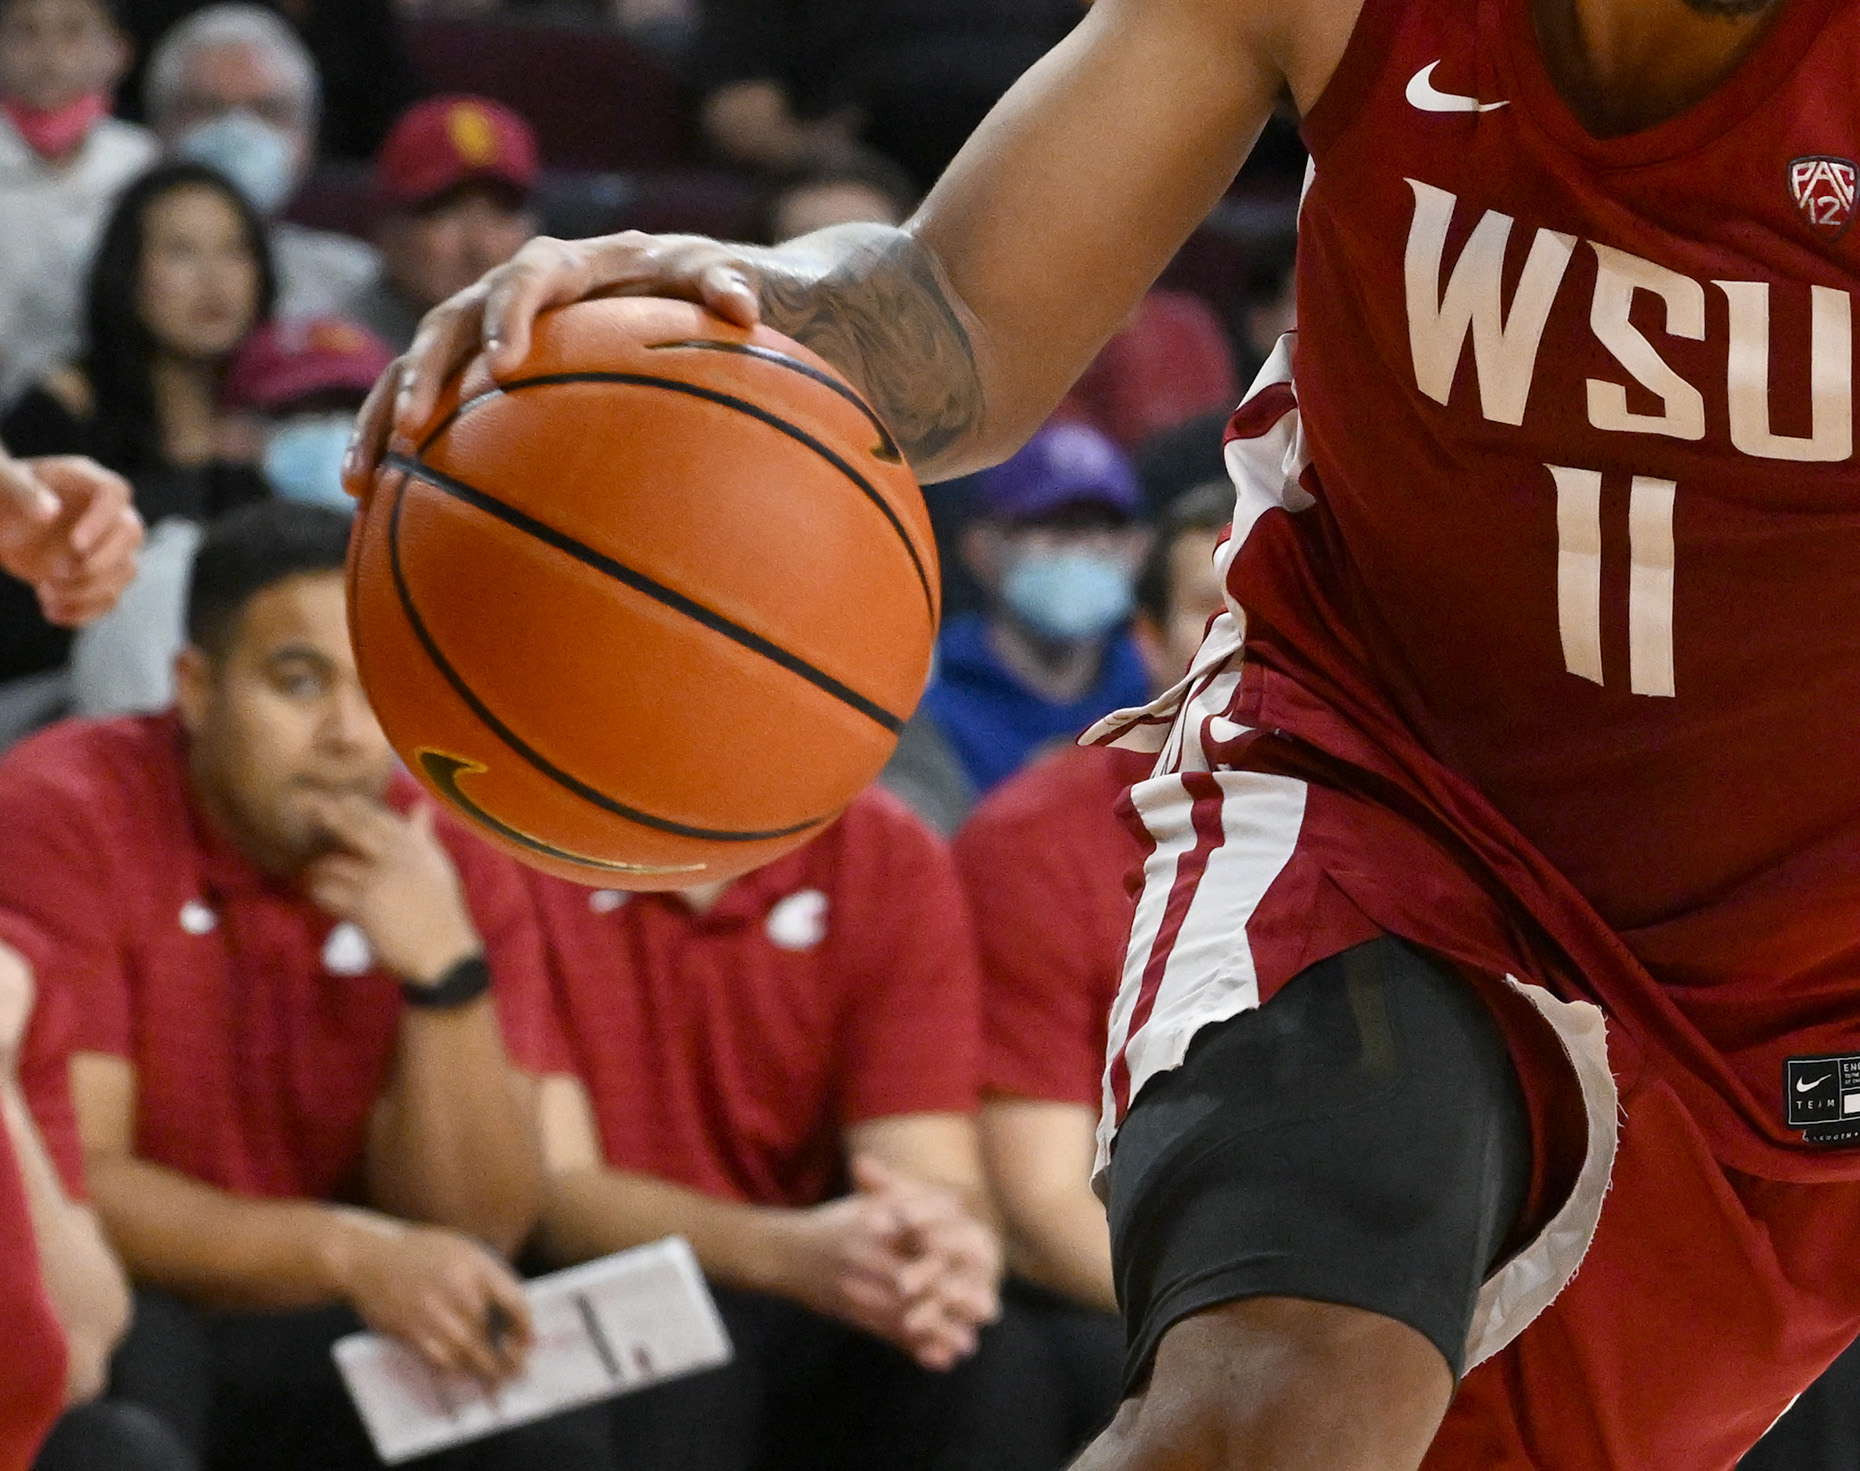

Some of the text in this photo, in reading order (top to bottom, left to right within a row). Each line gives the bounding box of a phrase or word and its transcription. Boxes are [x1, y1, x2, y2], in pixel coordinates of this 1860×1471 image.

[1792, 161, 1855, 212] PAC
[1808, 196, 1841, 225] 12
[1403, 177, 1853, 462] WSU
[1542, 463, 1677, 698] 11
[1796, 1098, 1836, 1110] TEAM
